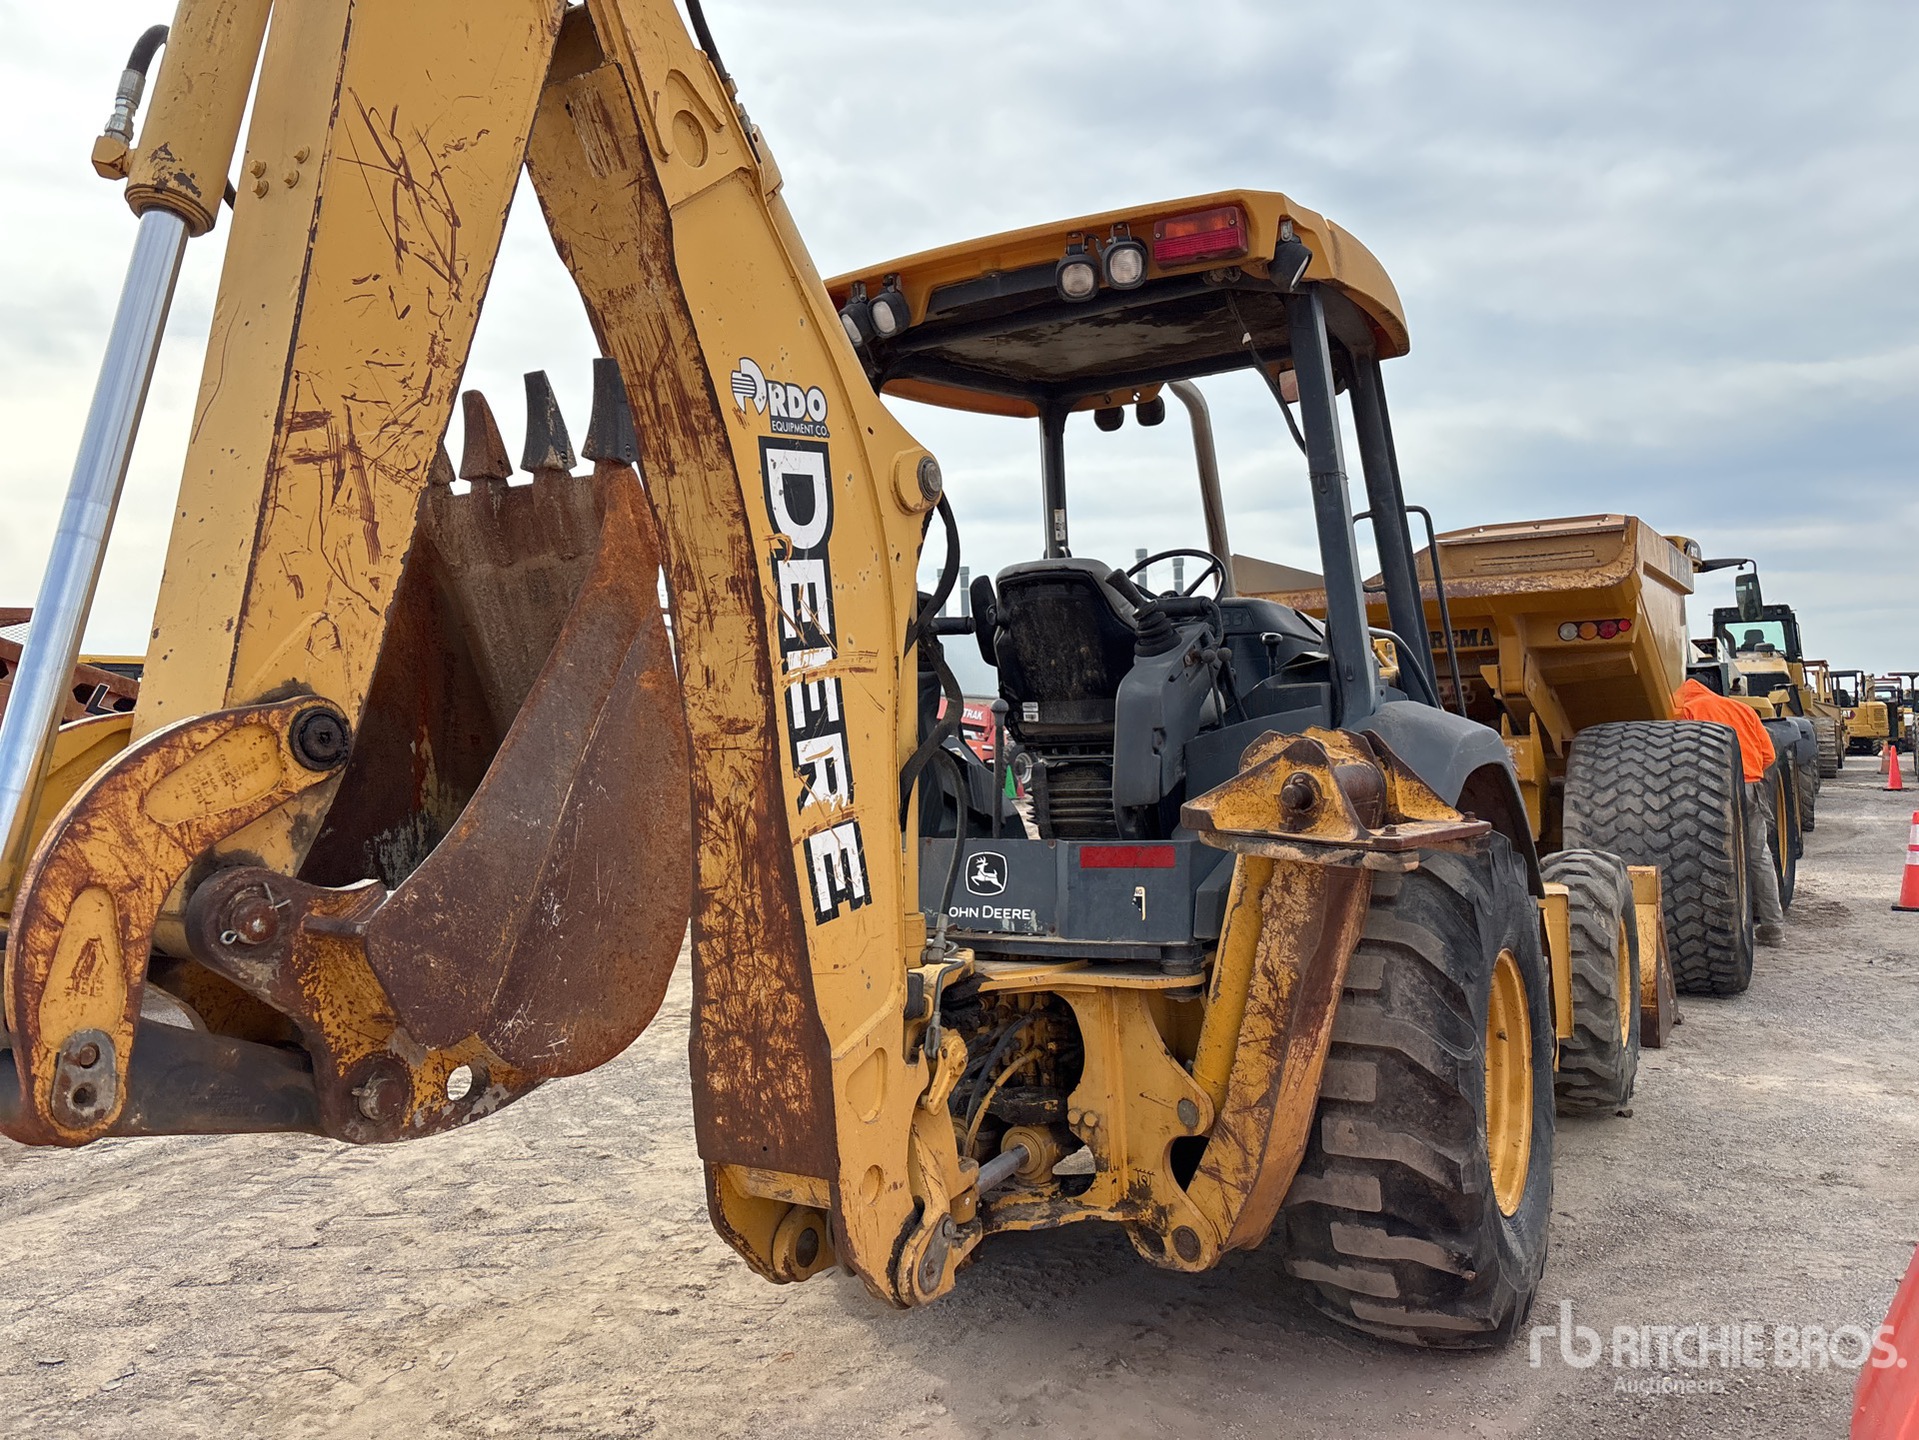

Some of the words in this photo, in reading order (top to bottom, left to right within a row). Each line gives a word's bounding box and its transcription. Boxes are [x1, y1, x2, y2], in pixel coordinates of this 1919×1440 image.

[771, 420, 814, 435] EQUIPMENT
[815, 425, 829, 437] CO.
[763, 444, 868, 914] DEERE
[948, 906, 979, 918] OHN
[982, 905, 1031, 920] DEERE
